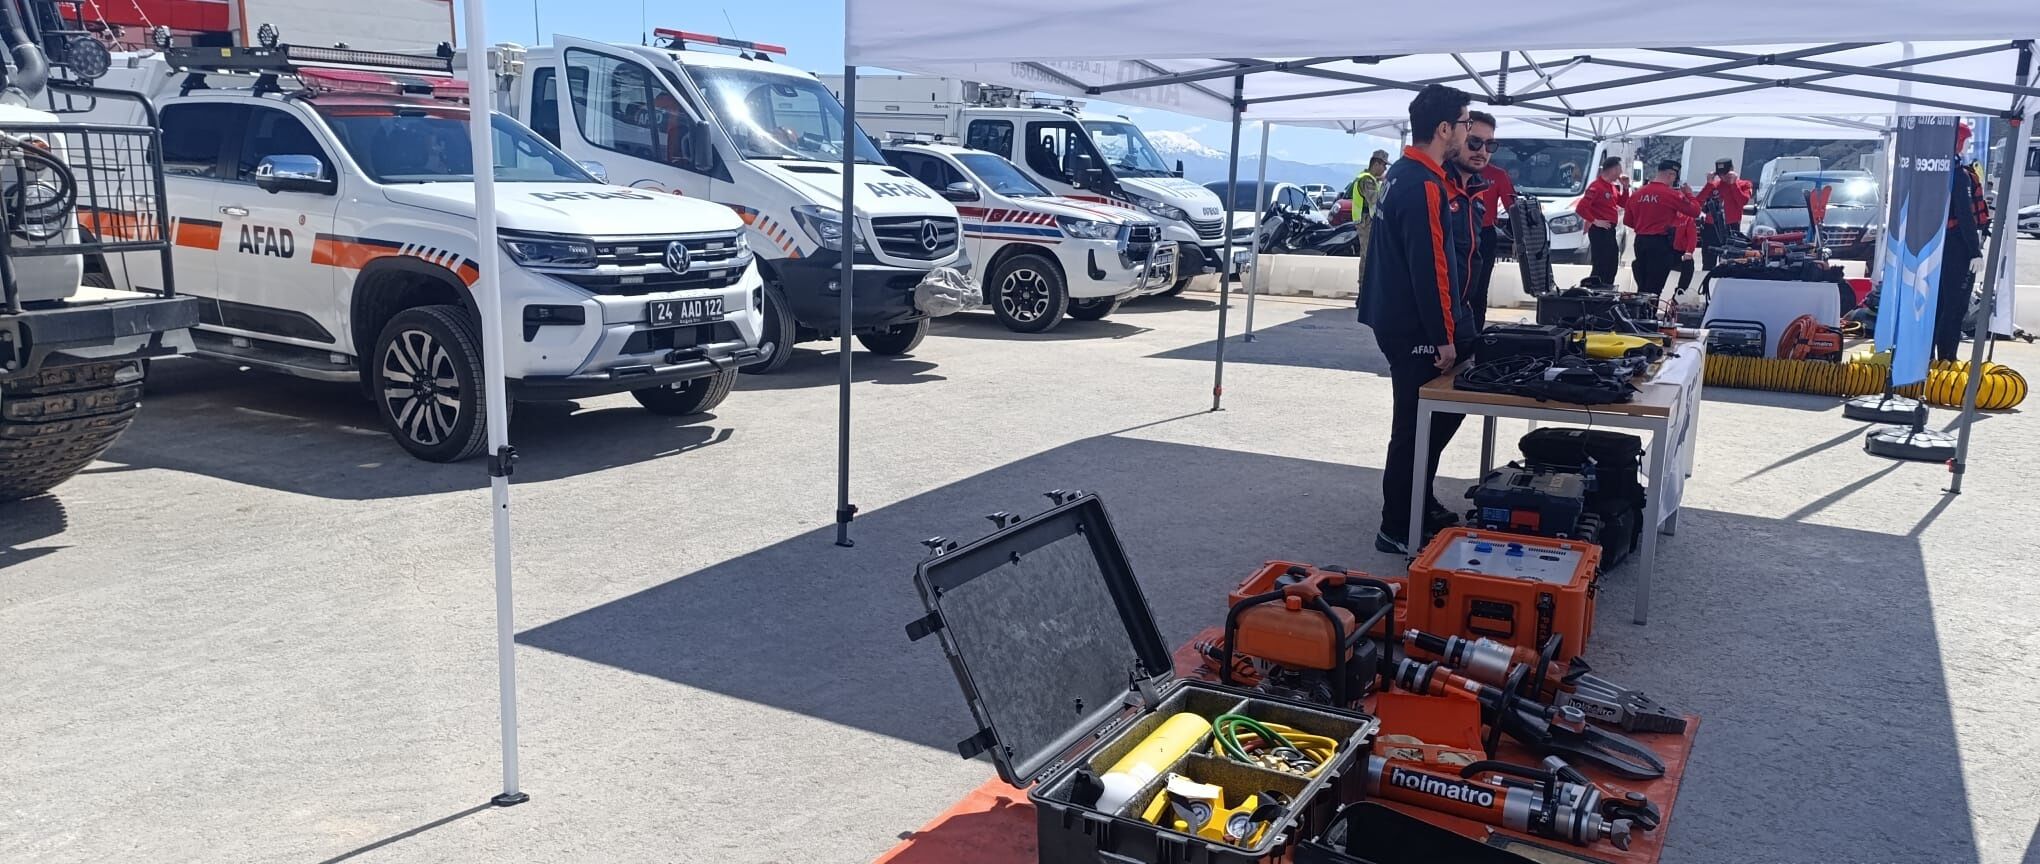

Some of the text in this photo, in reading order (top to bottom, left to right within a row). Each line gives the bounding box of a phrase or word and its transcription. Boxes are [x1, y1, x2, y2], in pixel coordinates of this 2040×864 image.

[528, 191, 654, 201] AFAD
[864, 182, 932, 199] AFAD
[238, 223, 295, 259] AFAD
[657, 298, 722, 320] 24 AAD 122
[1411, 344, 1435, 355] AFAD
[1391, 767, 1494, 807] holmatro
